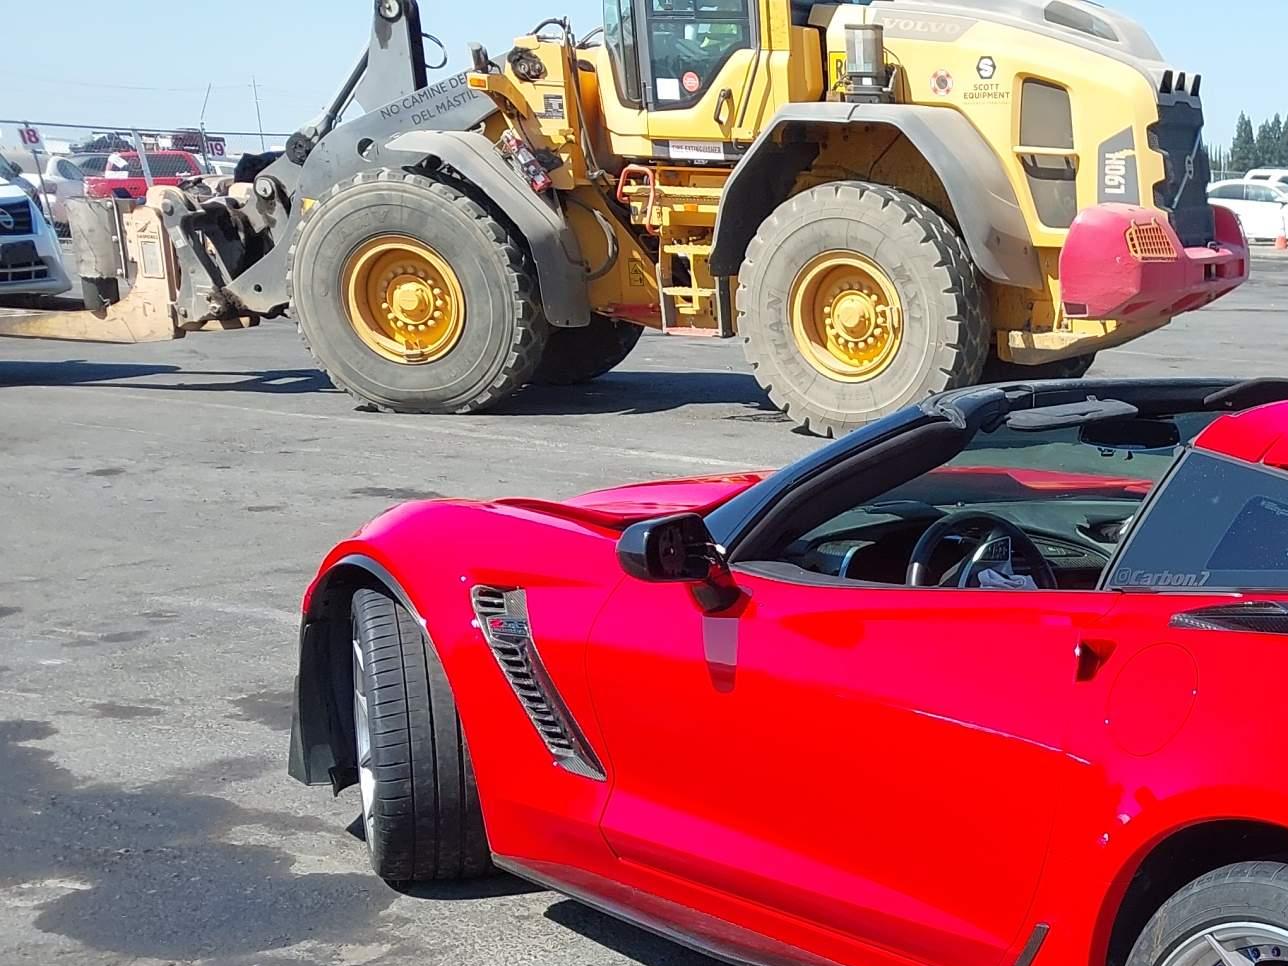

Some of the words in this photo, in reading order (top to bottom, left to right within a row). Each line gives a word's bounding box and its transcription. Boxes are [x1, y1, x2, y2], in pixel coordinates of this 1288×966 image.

[881, 17, 960, 34] VOLVO
[963, 91, 1010, 100] EQUIPMENT
[973, 83, 1000, 91] SCOTT
[380, 104, 400, 120] NO
[401, 82, 448, 109] CAMINE
[411, 108, 436, 125] DEL
[19, 128, 41, 145] 18
[208, 141, 225, 157] 19
[1104, 152, 1126, 194] L90H
